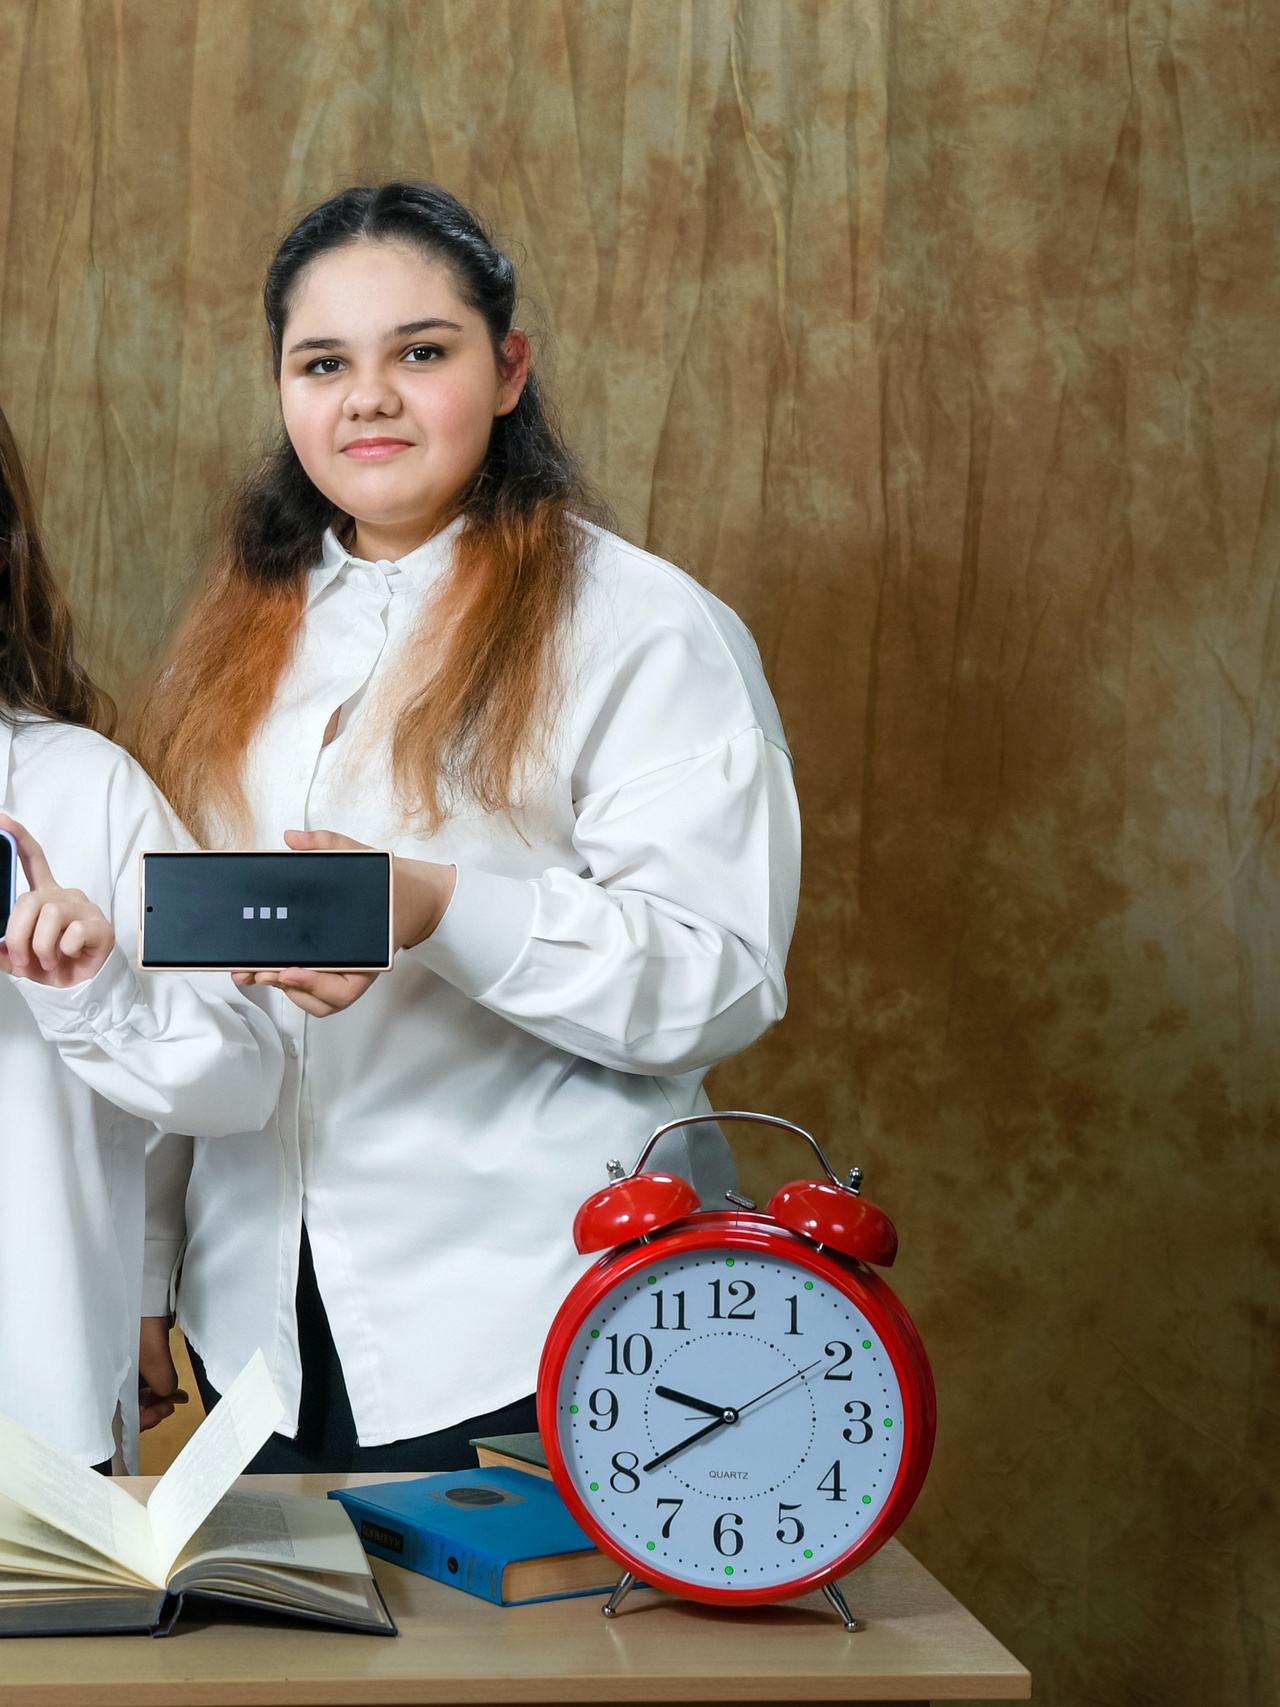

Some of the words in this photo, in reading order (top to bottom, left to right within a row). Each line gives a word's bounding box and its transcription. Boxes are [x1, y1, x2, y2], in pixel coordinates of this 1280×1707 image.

[651, 1290, 691, 1331] 11
[707, 1279, 756, 1320] 12
[785, 1295, 804, 1336] 1
[605, 1333, 653, 1376] 10
[824, 1341, 853, 1381] 2
[589, 1388, 619, 1431] 9
[842, 1400, 873, 1444] 3
[609, 1451, 641, 1494] 8
[708, 1470, 749, 1480] QUARTZ
[816, 1460, 847, 1502] 4
[656, 1498, 684, 1539] 7
[713, 1513, 744, 1556] 6
[776, 1503, 805, 1544] 5
